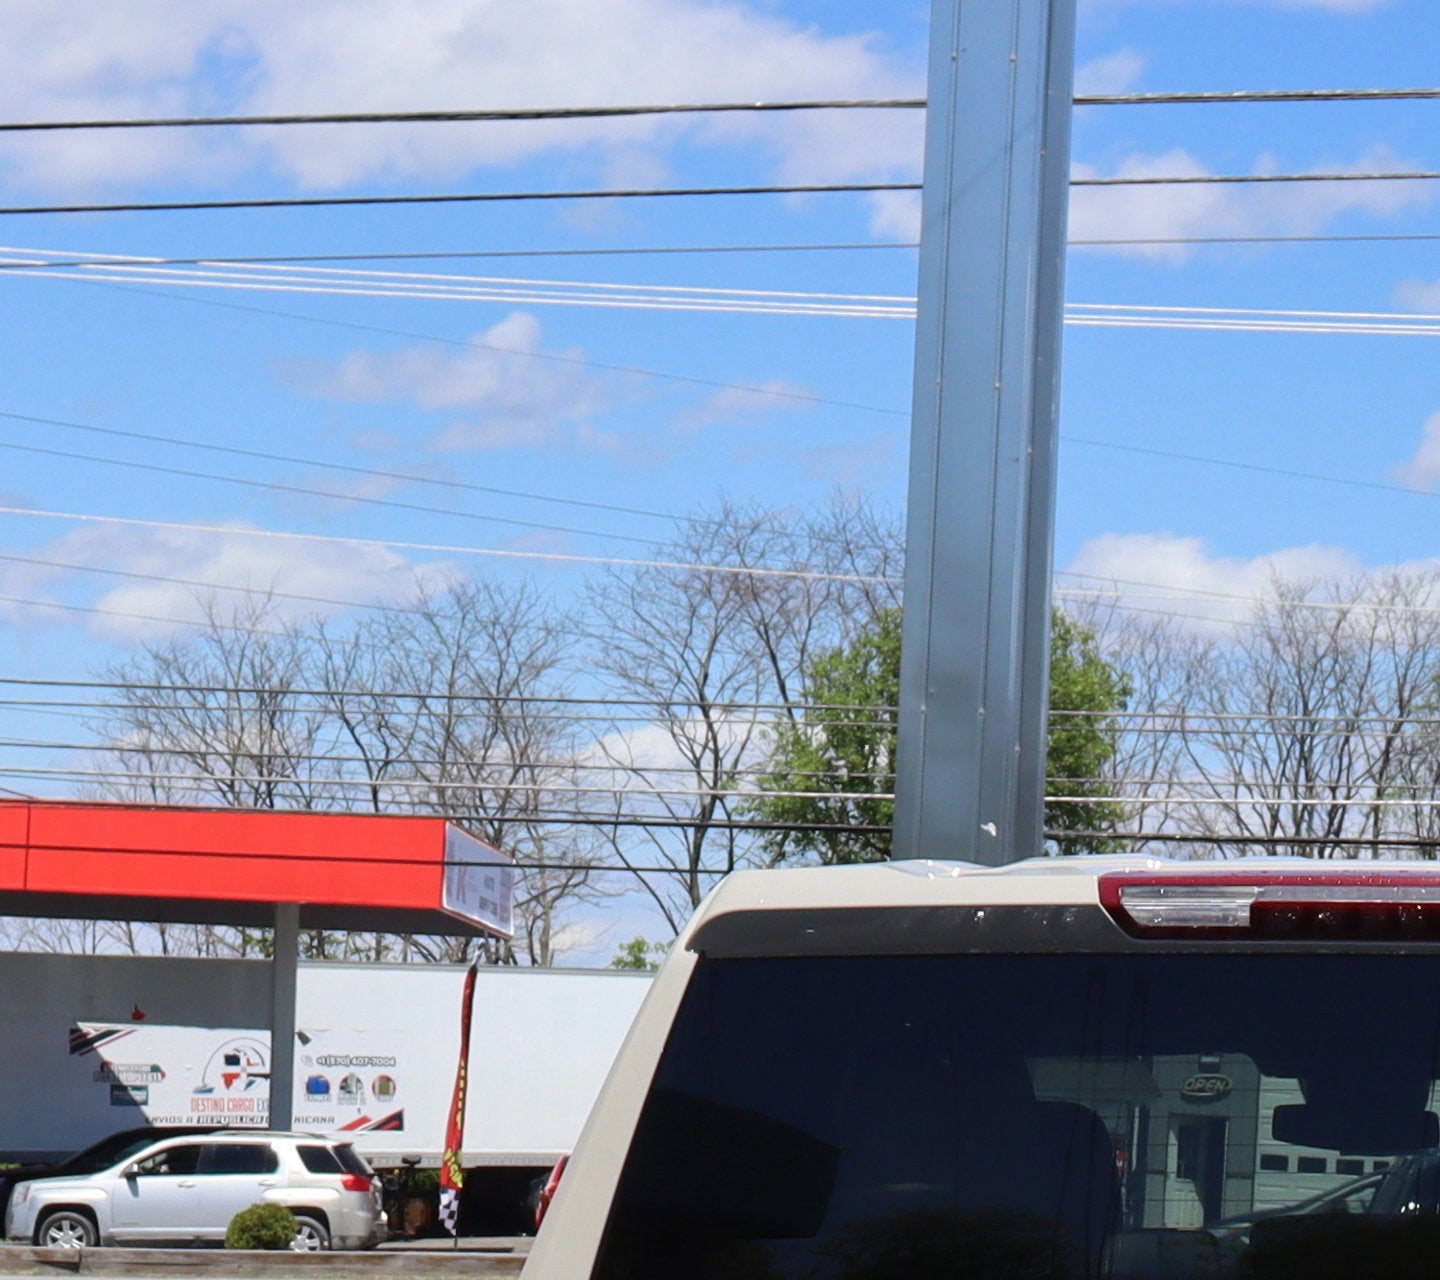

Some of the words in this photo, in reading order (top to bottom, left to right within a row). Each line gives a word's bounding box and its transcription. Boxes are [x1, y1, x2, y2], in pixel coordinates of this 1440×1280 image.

[327, 1055, 350, 1067] (570)
[1185, 1078, 1229, 1092] OPEN
[191, 1097, 225, 1112] DESTINO
[227, 1097, 255, 1112] CARGO
